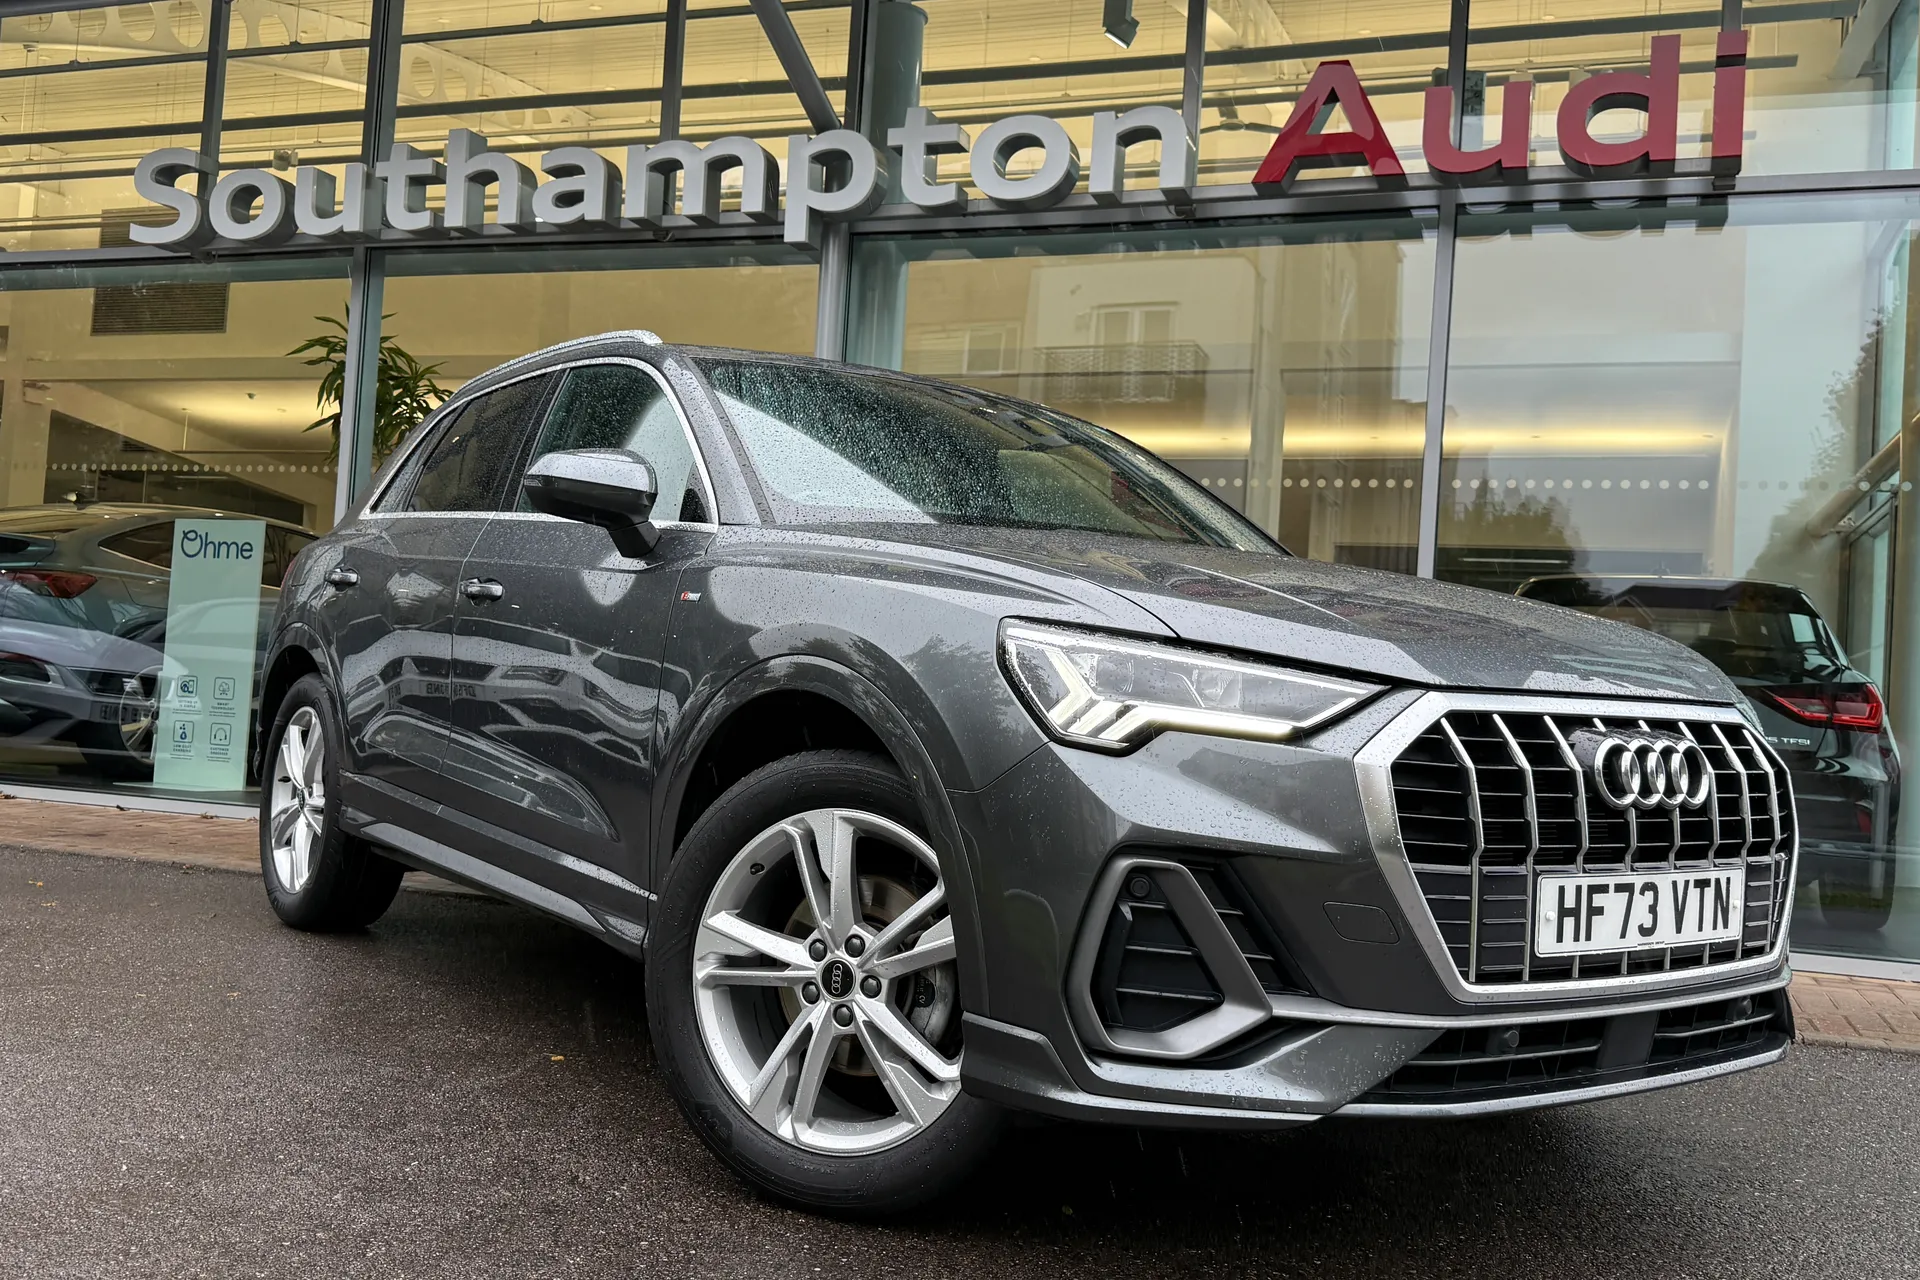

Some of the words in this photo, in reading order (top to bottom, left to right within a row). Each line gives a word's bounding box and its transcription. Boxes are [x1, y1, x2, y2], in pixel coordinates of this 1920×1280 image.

[129, 105, 1190, 245] Southampton
[1252, 30, 1748, 188] Audi
[181, 529, 253, 560] Ohme
[1780, 737, 1810, 746] TFSI
[1556, 881, 1659, 943] HF73
[1671, 877, 1731, 935] VTN
